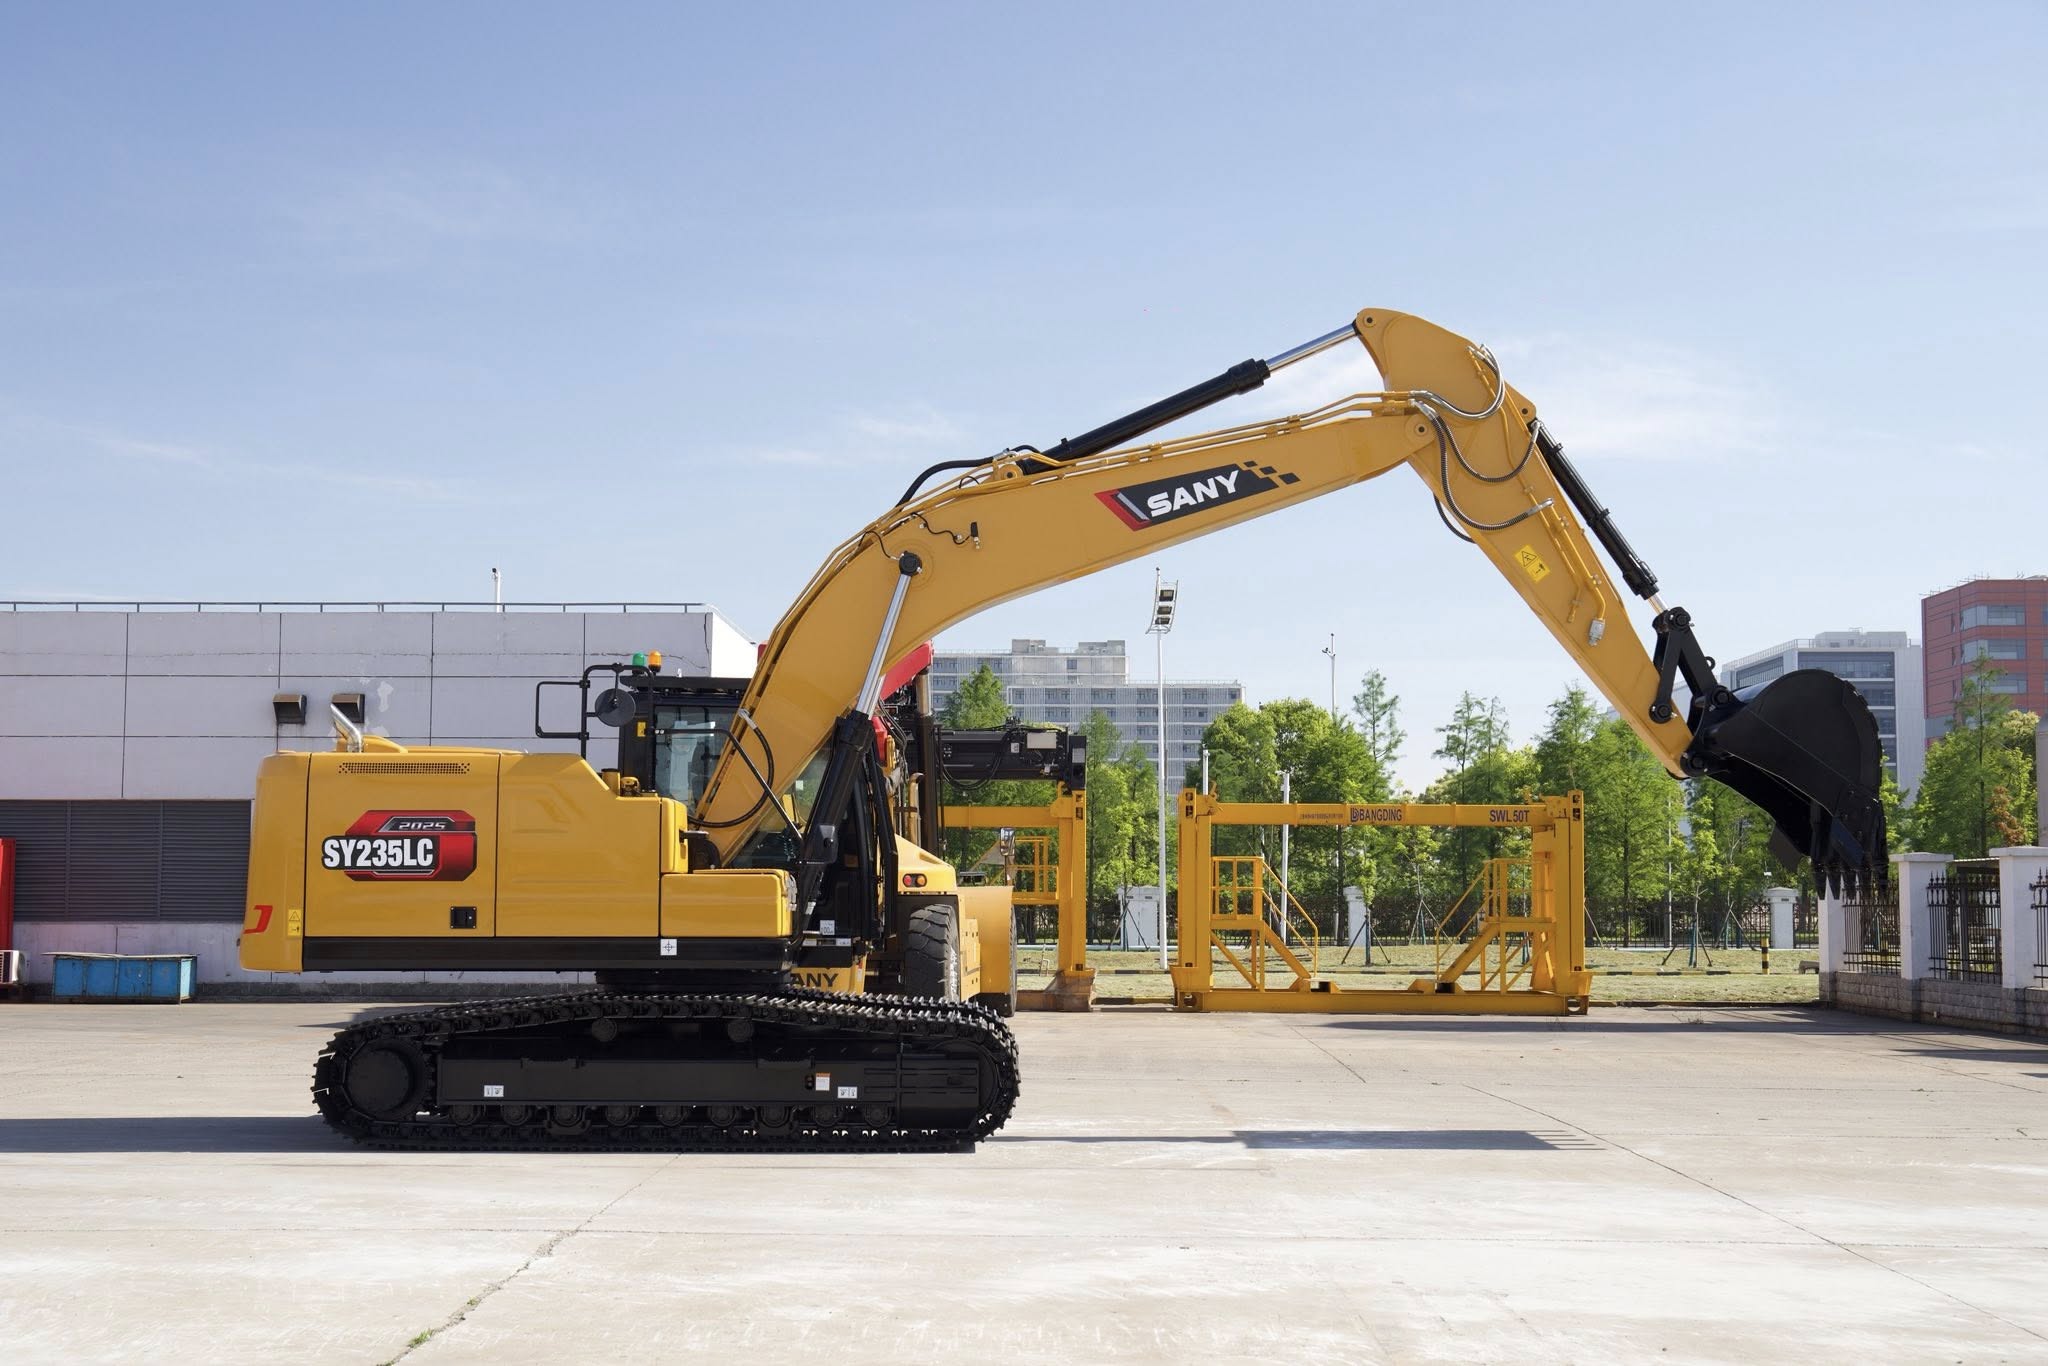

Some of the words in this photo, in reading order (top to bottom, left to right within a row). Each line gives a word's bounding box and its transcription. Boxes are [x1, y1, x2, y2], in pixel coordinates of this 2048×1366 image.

[1147, 469, 1239, 517] SANY
[1359, 808, 1403, 822] BANGDING
[1489, 809, 1512, 823] SWL
[1513, 809, 1530, 823] 50T
[398, 821, 447, 830] 2025
[323, 838, 434, 868] SY235LC
[790, 972, 839, 988] ANY
